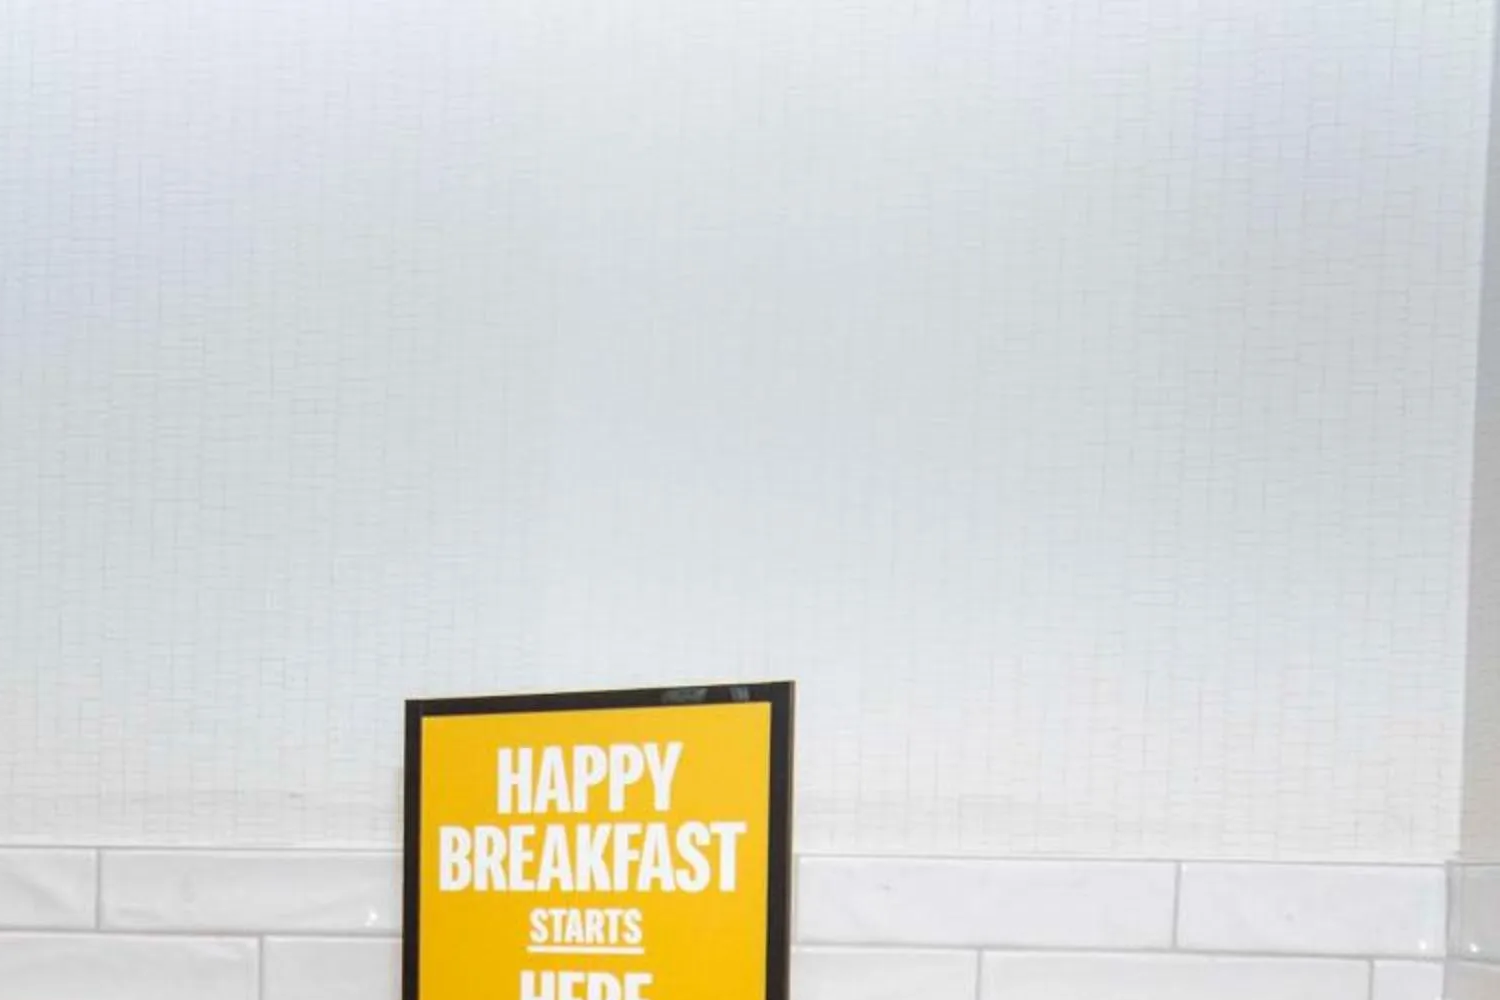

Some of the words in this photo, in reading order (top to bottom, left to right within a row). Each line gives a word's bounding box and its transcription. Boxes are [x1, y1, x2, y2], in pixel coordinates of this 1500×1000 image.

[496, 742, 683, 814] HAPPY
[439, 822, 746, 893] BREAKFAST
[529, 908, 643, 945] STARTS
